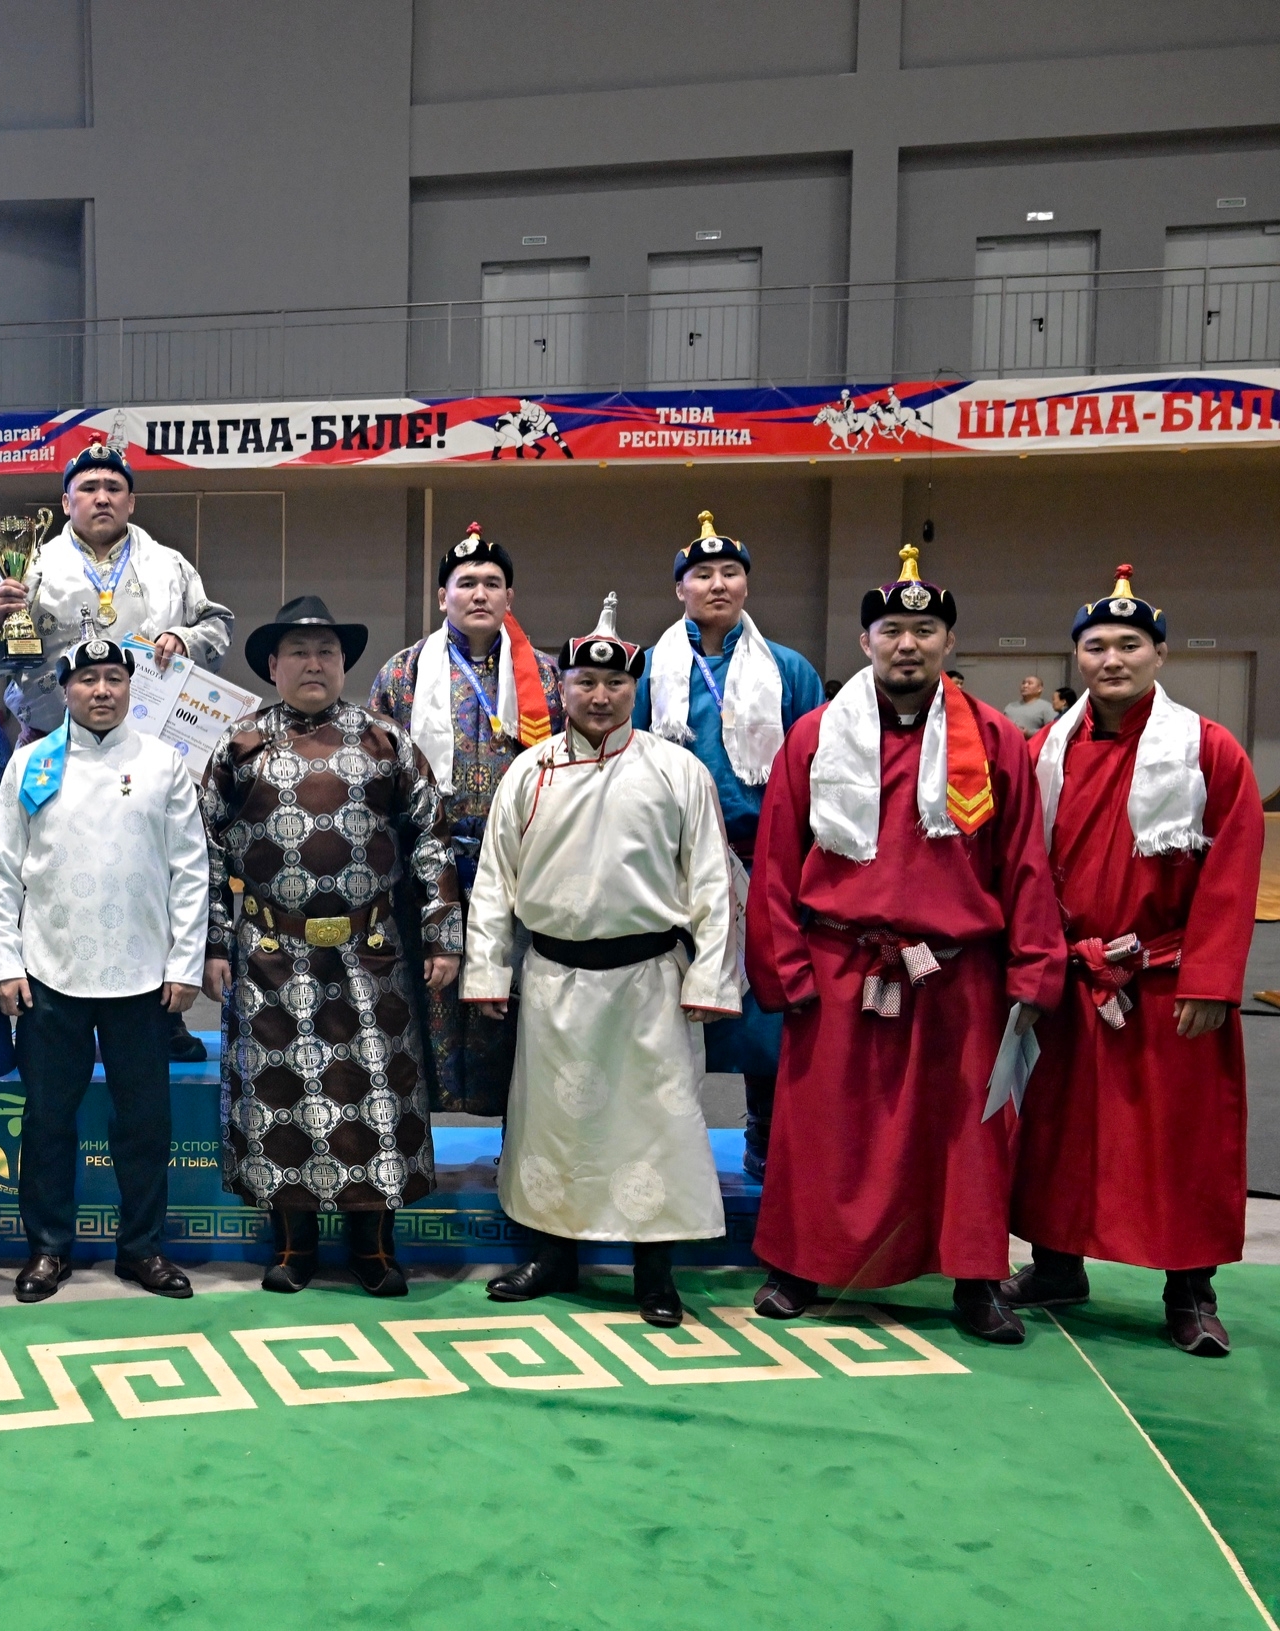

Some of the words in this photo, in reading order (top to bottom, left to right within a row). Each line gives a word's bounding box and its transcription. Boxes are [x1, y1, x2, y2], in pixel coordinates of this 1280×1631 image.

[656, 406, 715, 425] ТЫВА
[957, 389, 1280, 440] ШАГАА-БИЛ
[145, 412, 448, 456] ШАГАА-БИЛЕ!
[618, 429, 752, 448] РЕСПУБЛИКА
[179, 692, 231, 723] ФИКАТ
[182, 1141, 219, 1152] СПОР
[180, 1156, 218, 1168] ТЫВА
